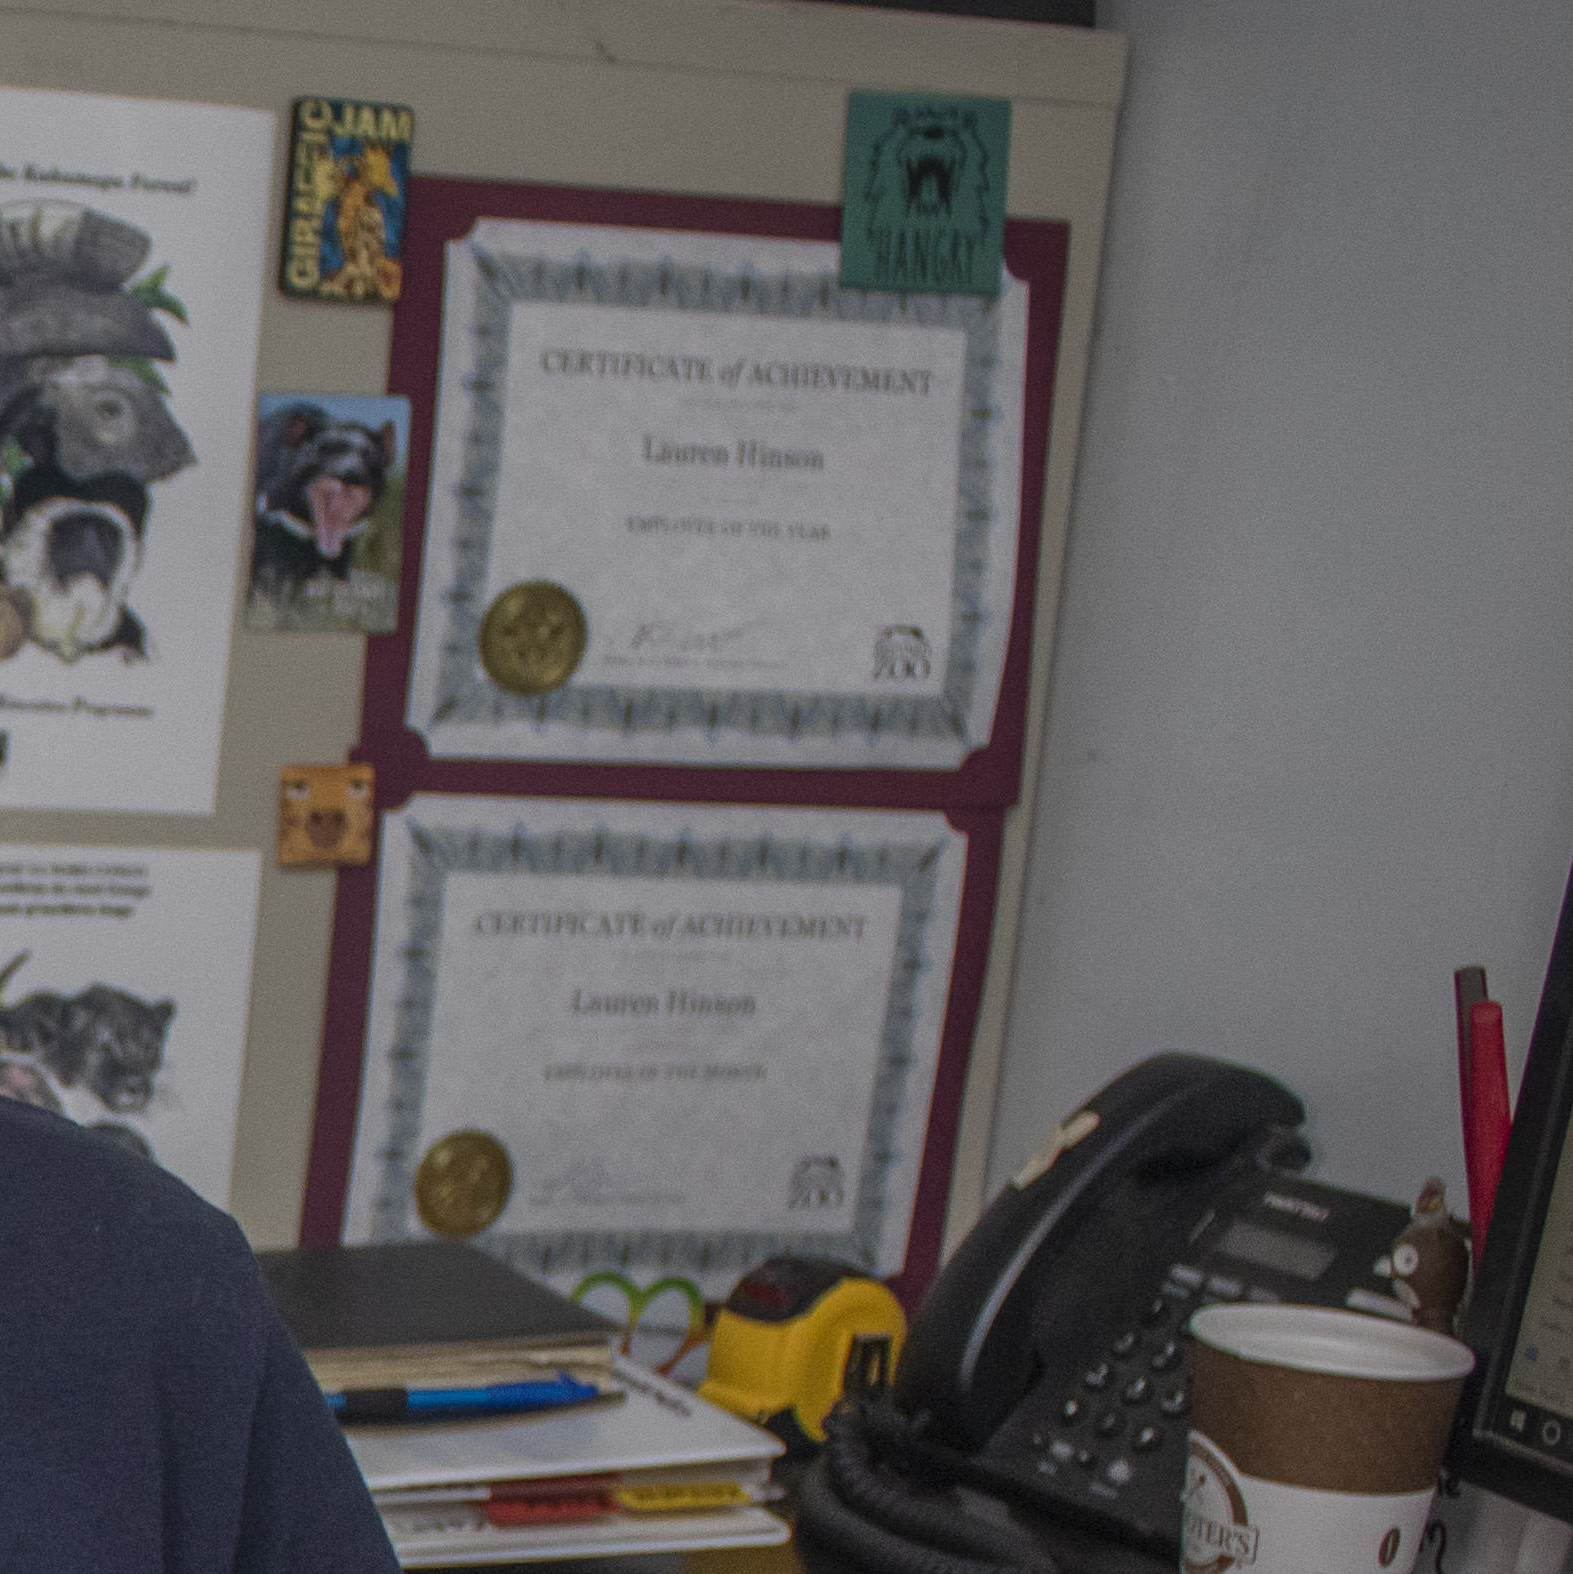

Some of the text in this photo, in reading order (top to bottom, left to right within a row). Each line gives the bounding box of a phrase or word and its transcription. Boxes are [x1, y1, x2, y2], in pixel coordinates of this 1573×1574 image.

[333, 103, 412, 141] JAM
[873, 227, 978, 286] HANGRY
[541, 347, 934, 398] CERTIFICATE of ACHIEVEMENT
[642, 434, 731, 469] Lauren
[474, 910, 646, 940] CERTIFICATE
[679, 911, 869, 942] ACHIEVEMENT
[1184, 1516, 1250, 1556] OTER'S
